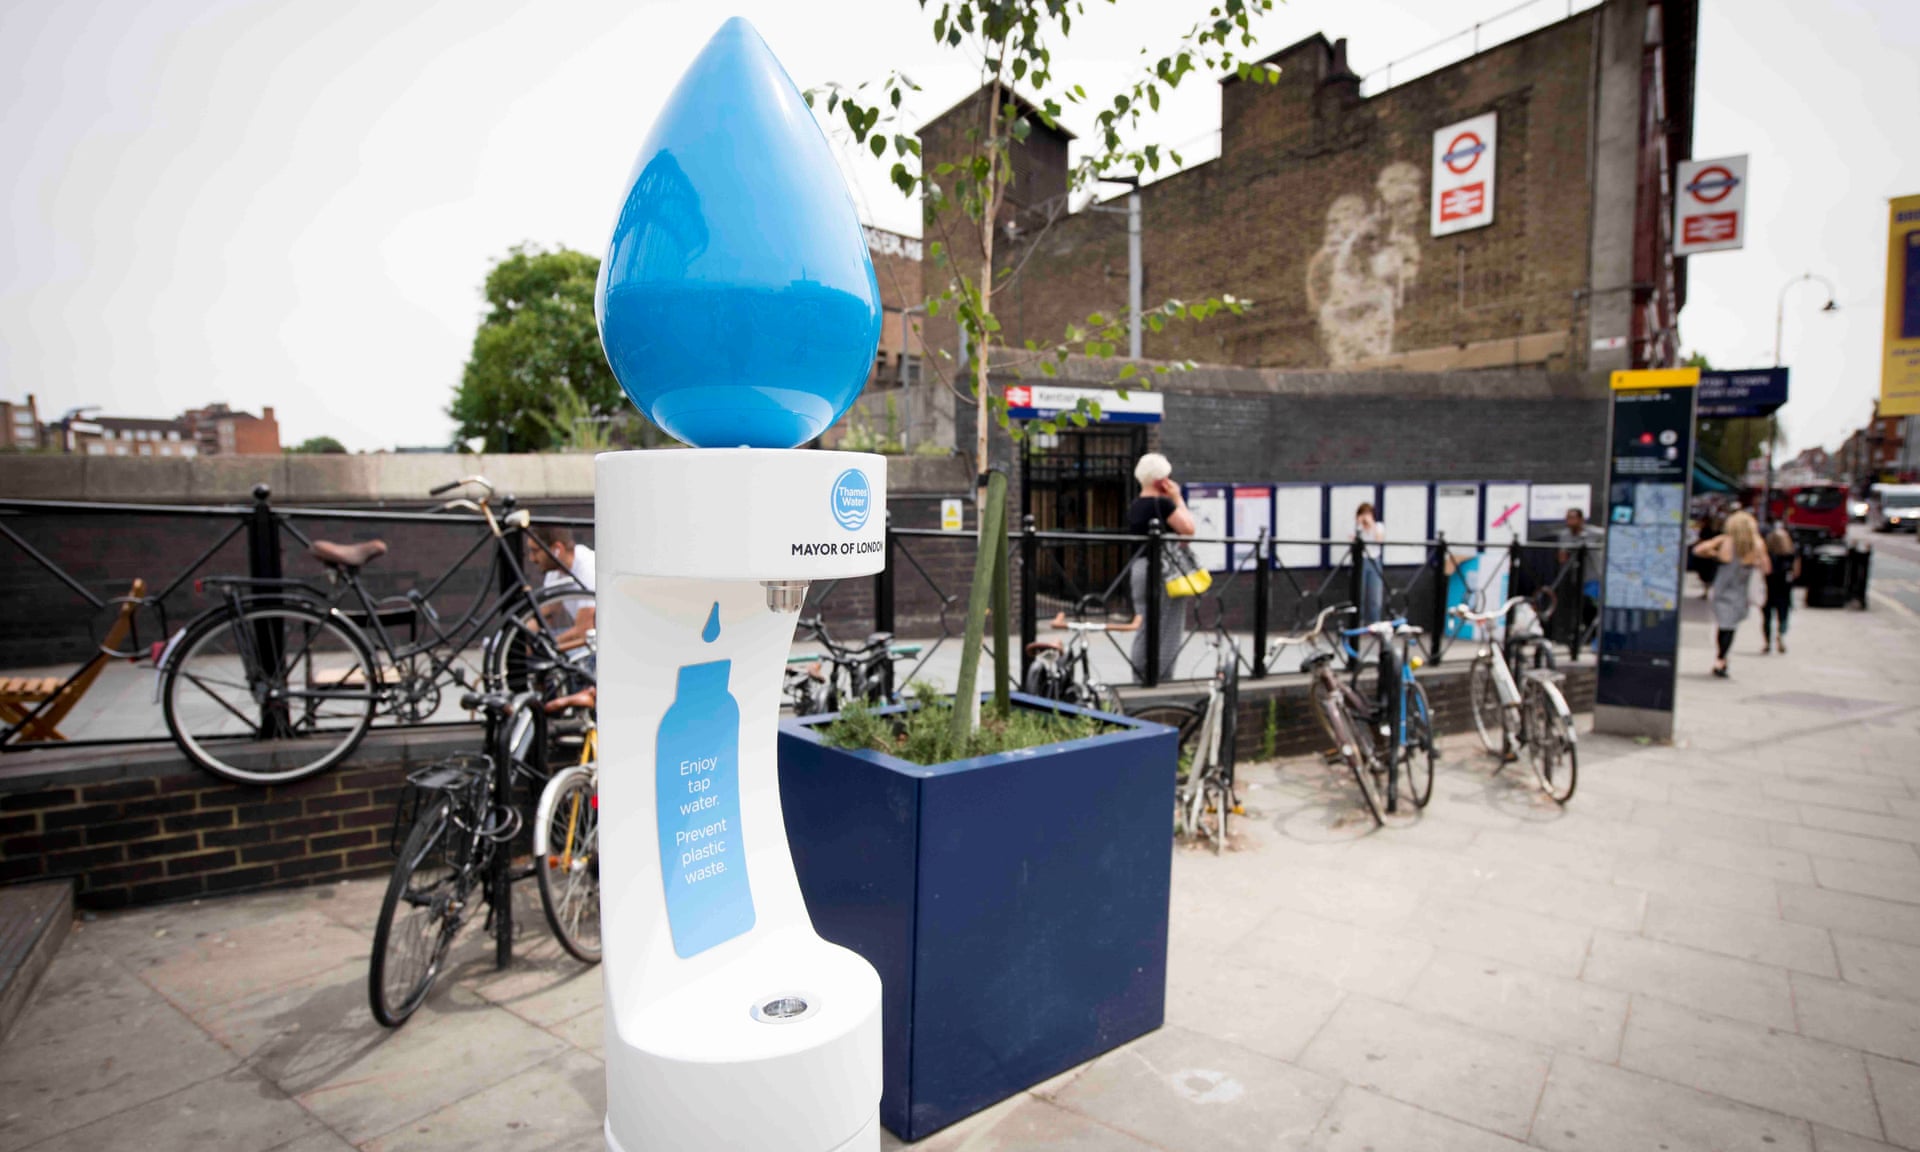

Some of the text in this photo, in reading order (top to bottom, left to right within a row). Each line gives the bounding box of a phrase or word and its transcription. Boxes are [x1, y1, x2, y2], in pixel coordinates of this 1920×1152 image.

[839, 487, 867, 497] Thames
[842, 497, 864, 506] Water
[791, 543, 838, 556] MAYOR
[840, 542, 855, 555] OF
[680, 756, 718, 776] Enjoy
[688, 777, 711, 793] tap
[680, 794, 720, 816] water.
[676, 818, 728, 846] Prevent
[682, 840, 726, 868] plastic
[685, 861, 728, 884] waste.
